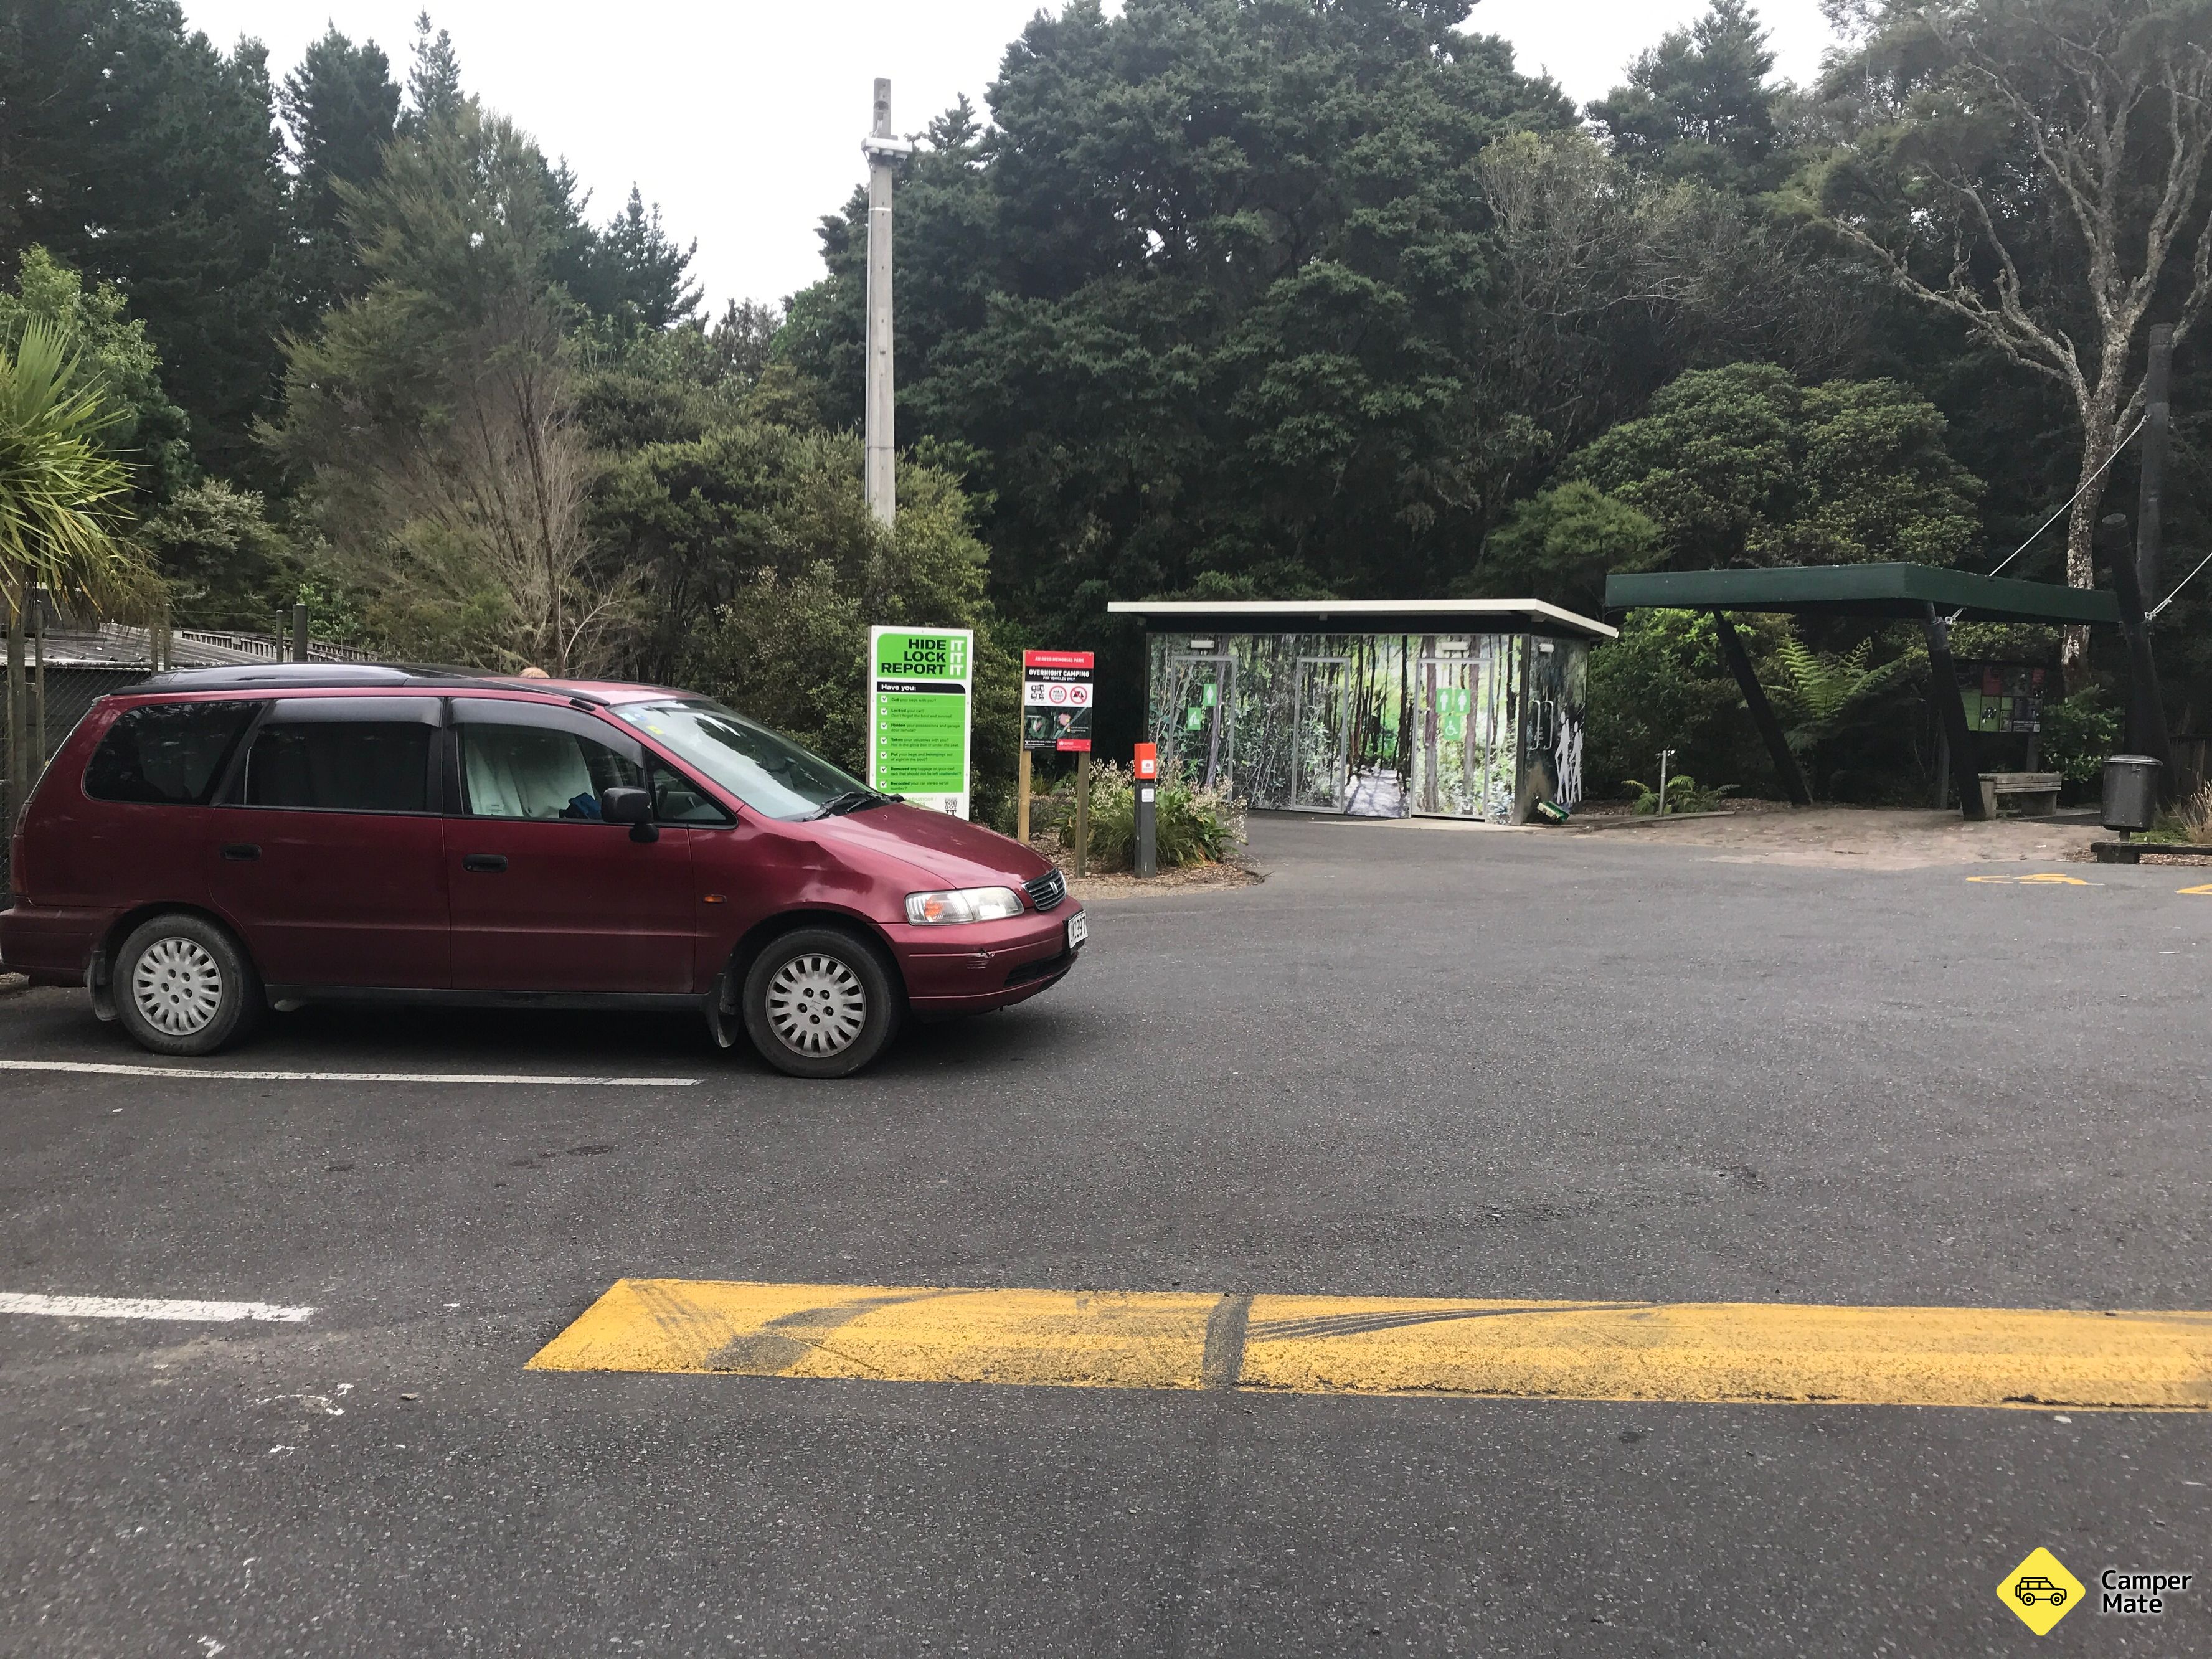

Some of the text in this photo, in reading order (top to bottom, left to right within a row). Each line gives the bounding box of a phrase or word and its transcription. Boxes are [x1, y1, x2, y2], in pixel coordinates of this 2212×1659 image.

[908, 639, 964, 651] HIDE IT
[904, 651, 963, 664] LOCK IT
[881, 663, 963, 676] REPORT IT
